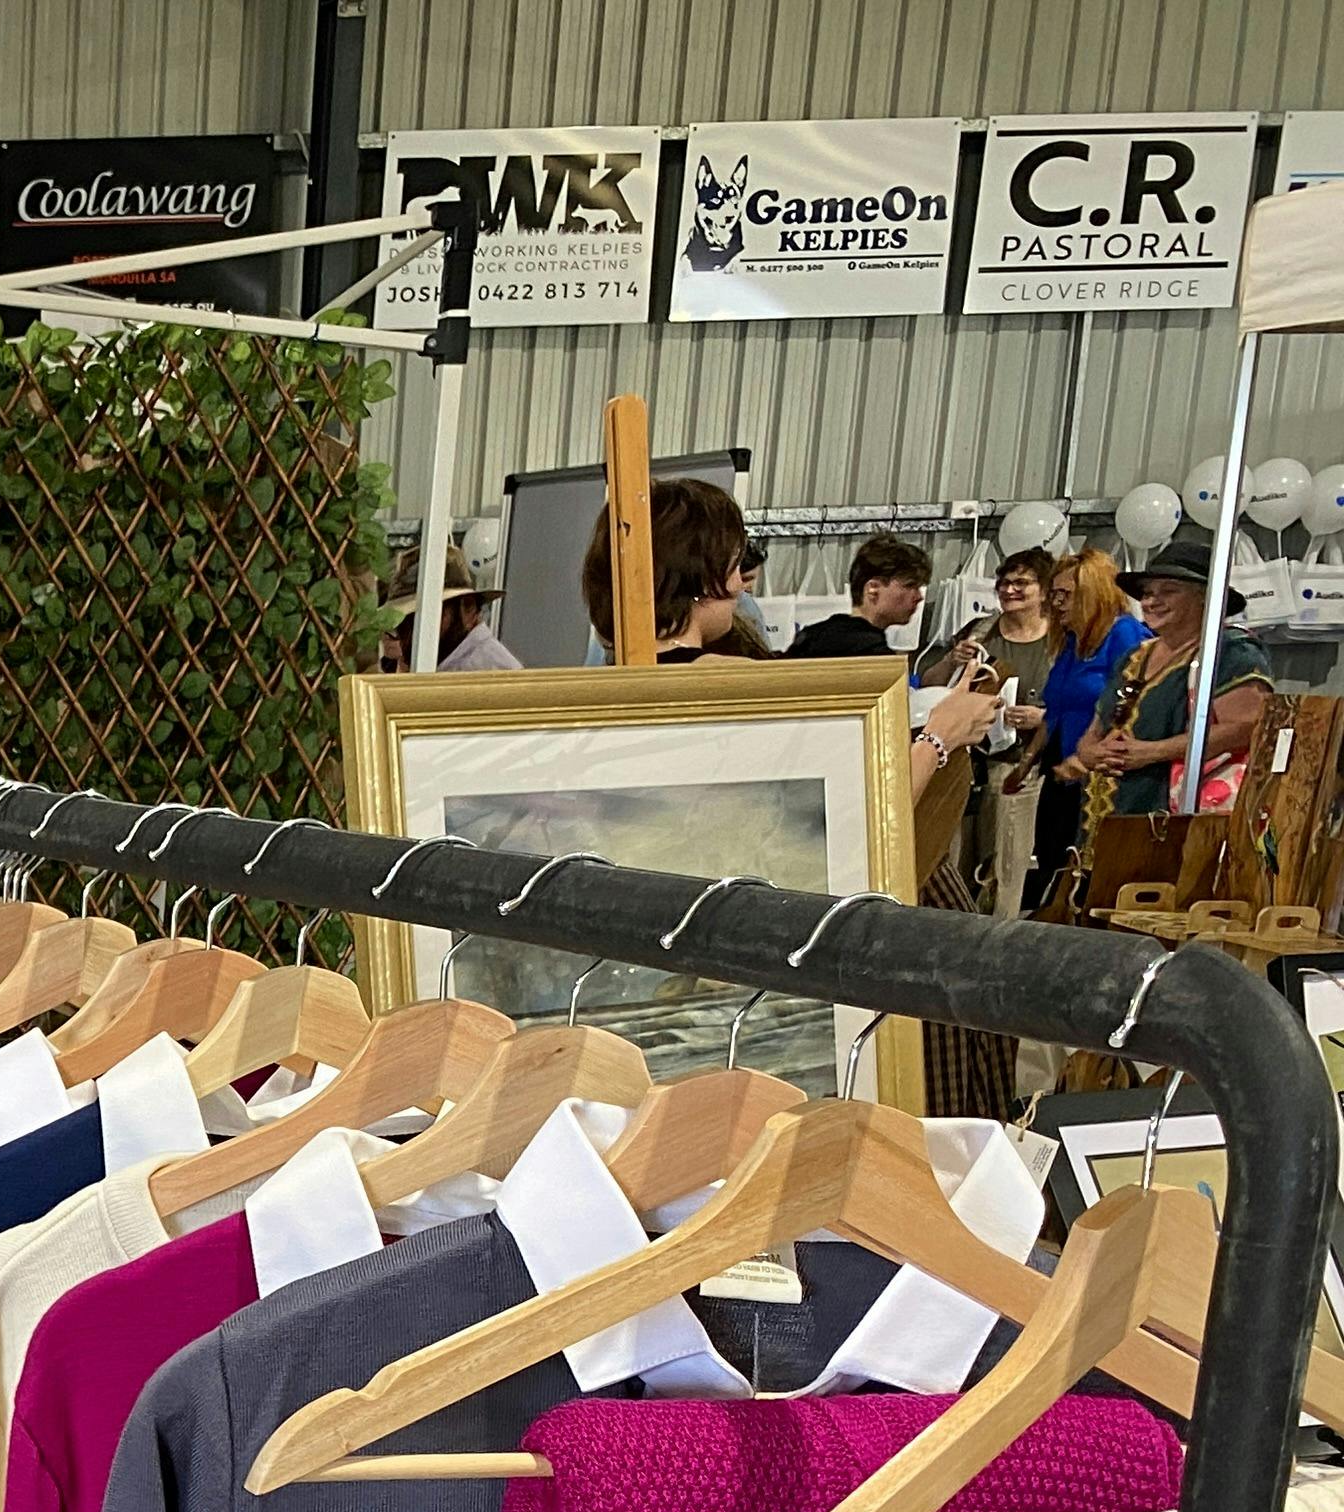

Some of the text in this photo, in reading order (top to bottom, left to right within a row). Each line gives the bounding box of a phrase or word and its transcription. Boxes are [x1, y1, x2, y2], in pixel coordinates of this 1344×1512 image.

[1009, 139, 1217, 228] C.R.
[17, 171, 256, 228] Coolawang
[745, 185, 948, 225] GameOn
[473, 242, 643, 257] WORKING KELPIES
[778, 228, 908, 252] KELPIES
[1001, 231, 1214, 262] PASTORAL
[514, 259, 630, 273] CONTRACTING
[858, 261, 901, 270] GameOn
[159, 269, 178, 284] SA
[478, 283, 534, 301] 0422
[545, 282, 587, 299] 813
[598, 280, 639, 298] 714
[1002, 279, 1200, 302] CLOVER RIDGE
[1244, 589, 1275, 600] udika
[1314, 591, 1344, 600] Audik
